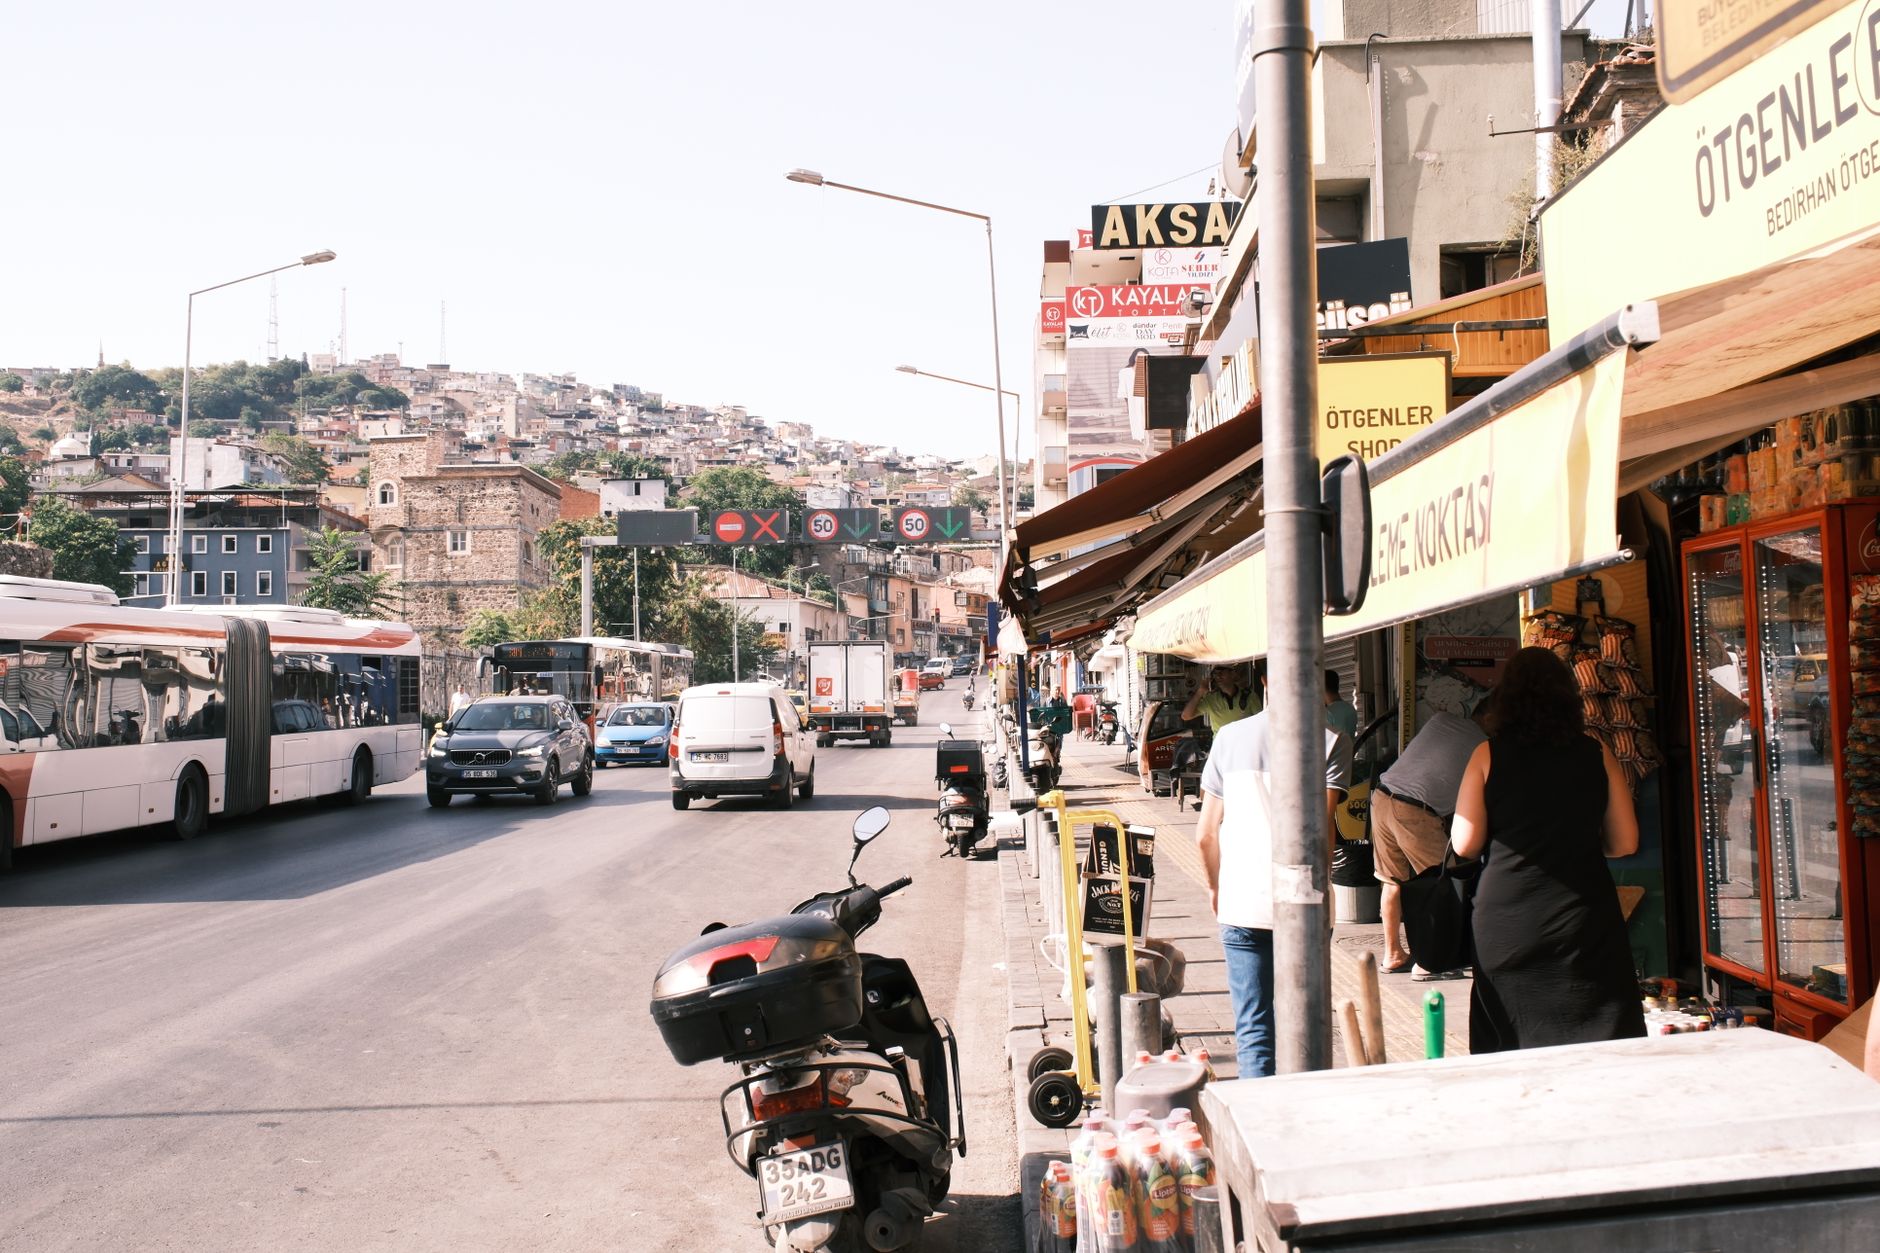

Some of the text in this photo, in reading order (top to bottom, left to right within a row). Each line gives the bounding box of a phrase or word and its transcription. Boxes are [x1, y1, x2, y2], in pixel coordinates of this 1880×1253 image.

[1766, 167, 1837, 237] BEDİRHAN
[1326, 405, 1433, 430] ÖTGENLER
[813, 518, 832, 534] 50
[904, 517, 924, 532] 50
[1413, 471, 1496, 571] NOKTASI
[781, 1176, 828, 1208] 242
